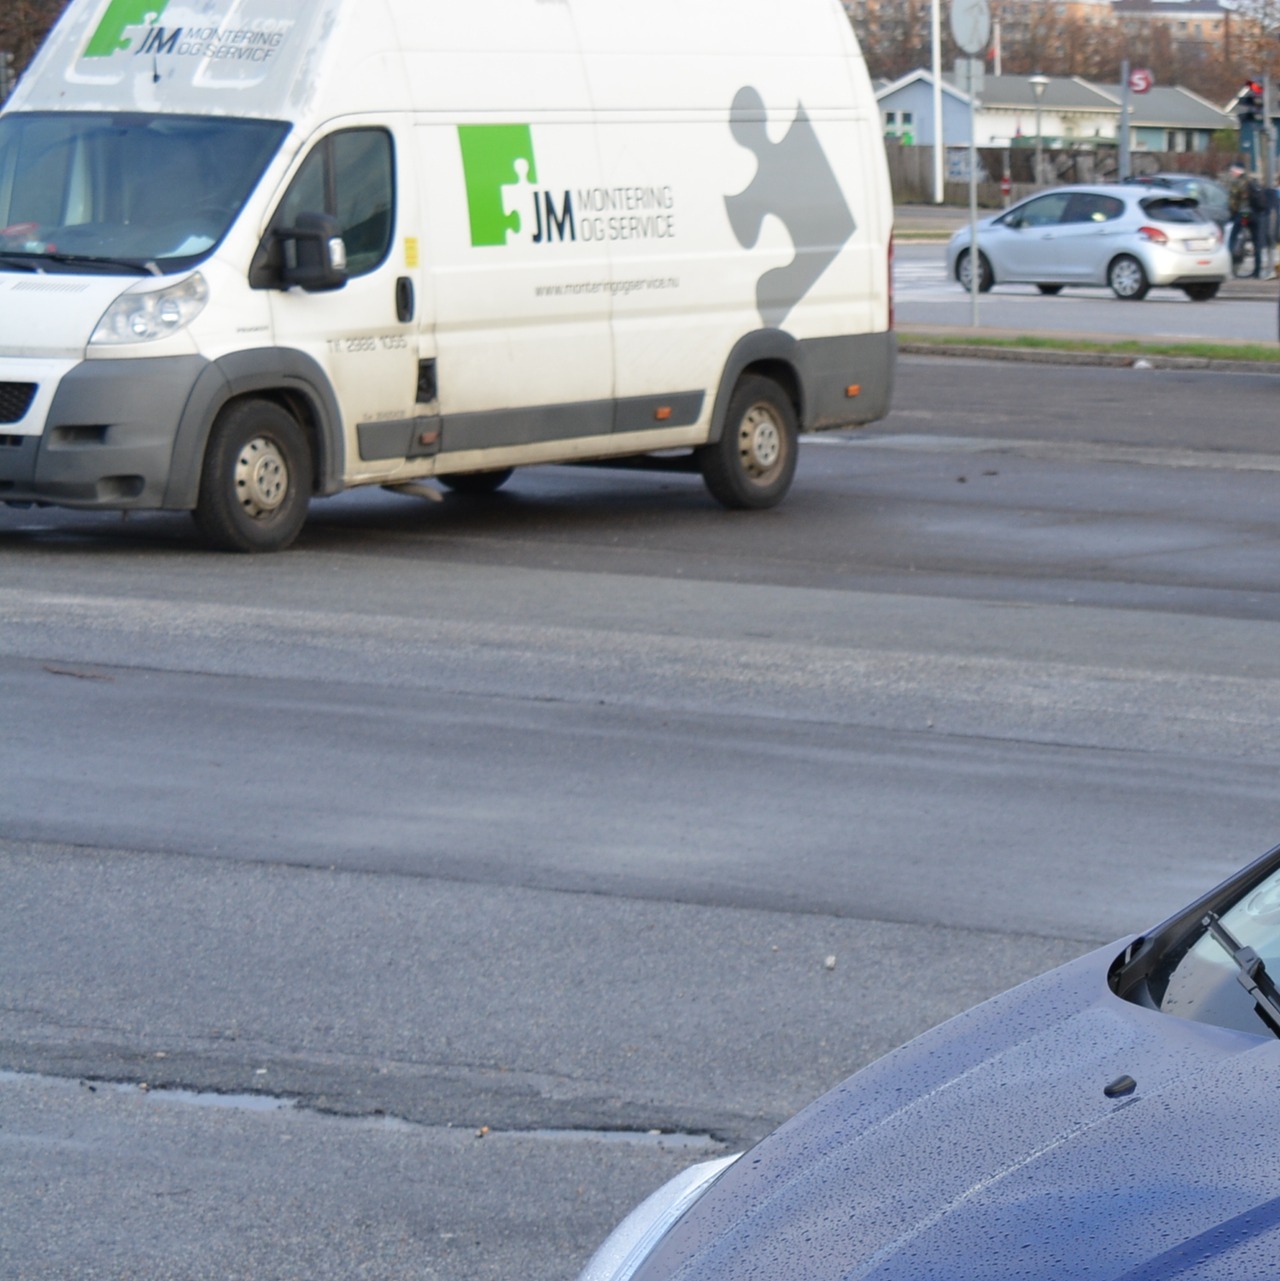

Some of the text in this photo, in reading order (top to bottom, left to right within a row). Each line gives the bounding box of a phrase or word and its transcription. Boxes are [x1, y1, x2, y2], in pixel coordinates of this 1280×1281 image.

[135, 26, 184, 56] JM
[177, 41, 201, 57] OG
[186, 27, 284, 48] MONTERING
[1130, 73, 1149, 91] S
[578, 186, 674, 212] MONTERING
[532, 189, 576, 243] JM
[580, 215, 676, 242] OG SERVICE
